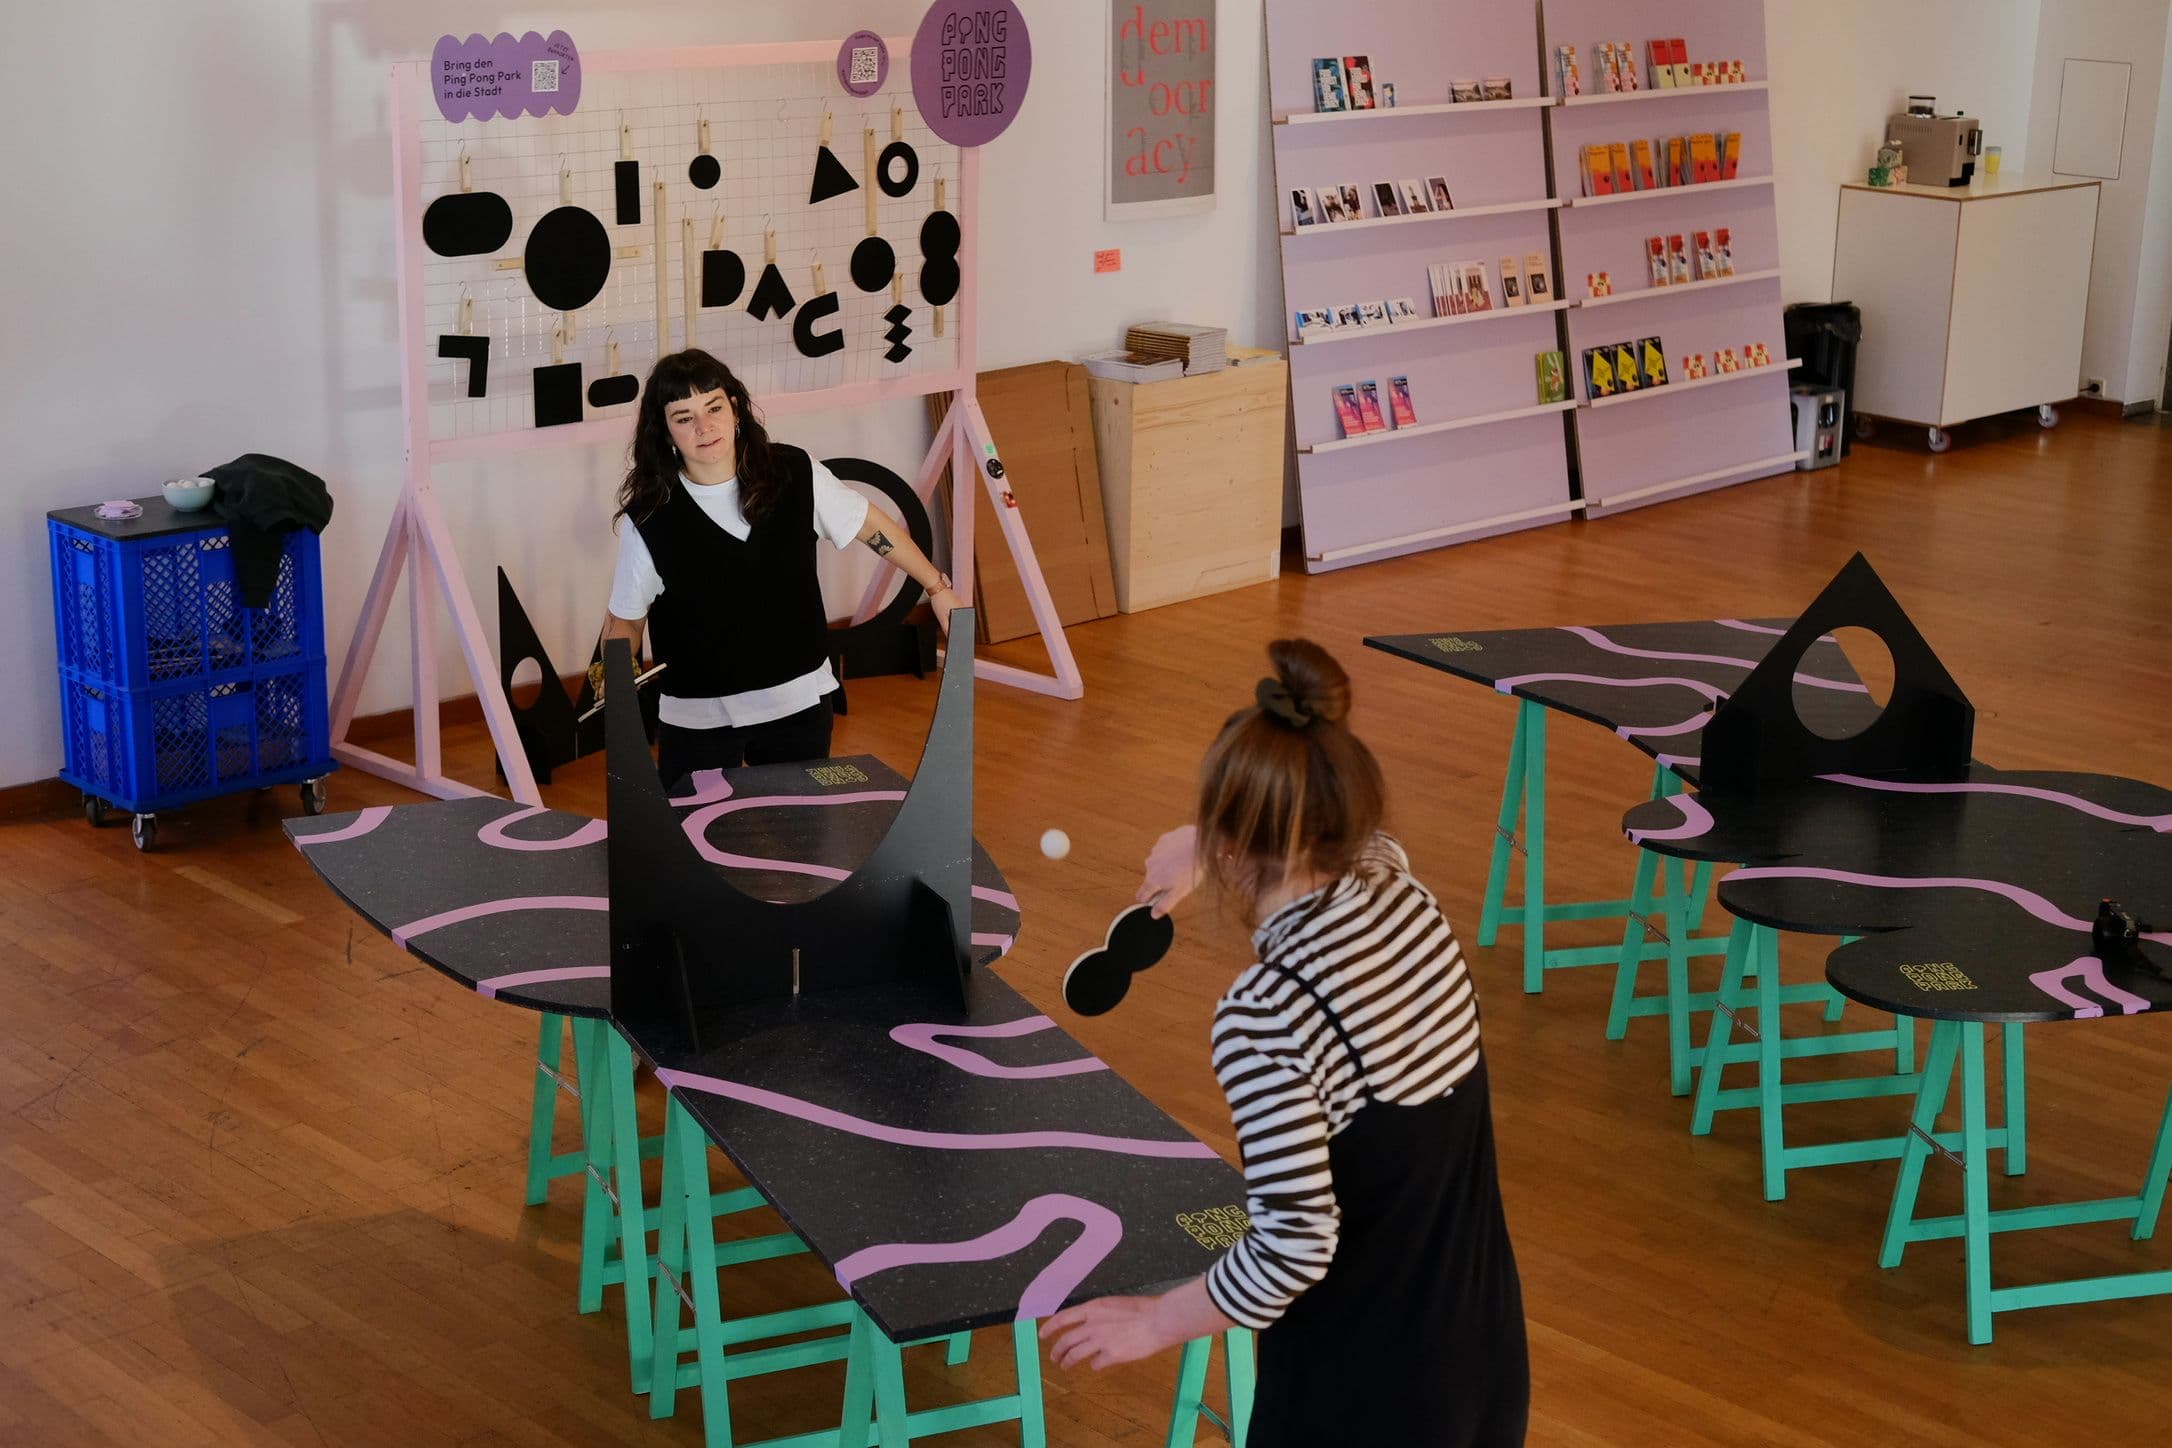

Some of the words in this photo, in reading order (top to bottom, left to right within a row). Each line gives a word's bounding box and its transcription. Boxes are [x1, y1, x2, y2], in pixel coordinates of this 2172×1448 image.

[941, 10, 1007, 46] PING
[444, 60, 471, 71] Bring
[474, 59, 493, 69] den
[941, 46, 1006, 82] PONG
[444, 75, 466, 86] Ping
[469, 72, 495, 85] Pong
[497, 70, 522, 81] Park
[443, 89, 454, 100] in
[455, 88, 472, 99] die
[474, 86, 502, 98] Stadt
[941, 82, 1004, 119] PARK
